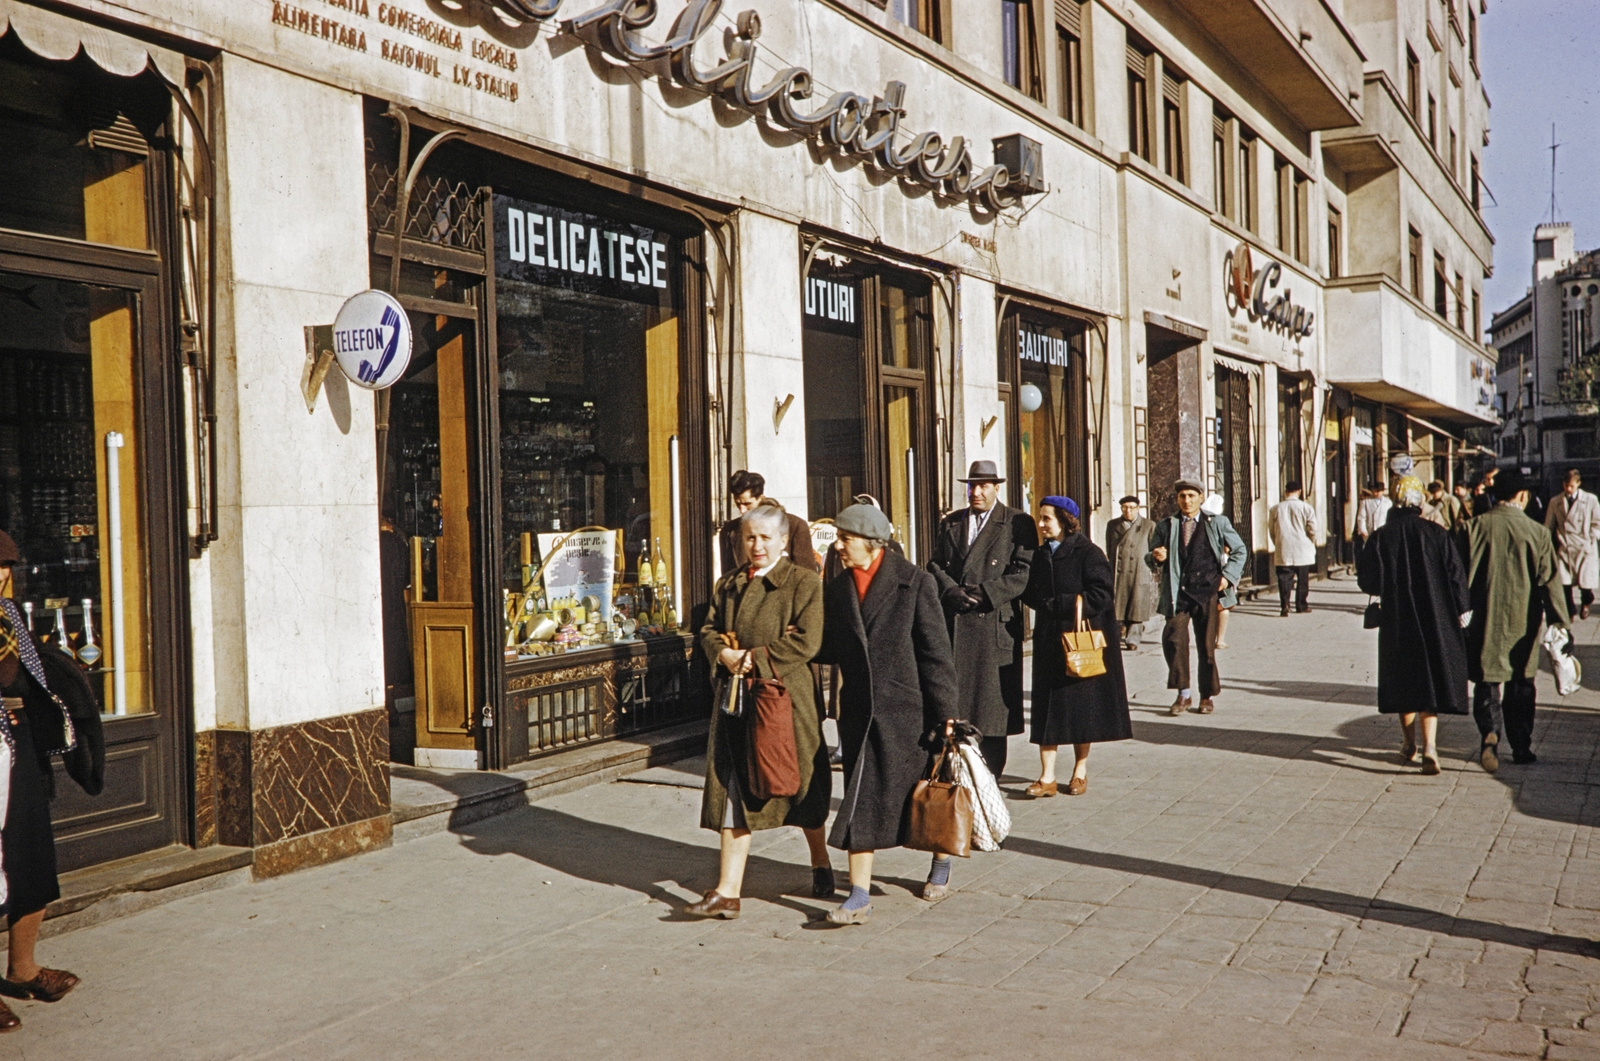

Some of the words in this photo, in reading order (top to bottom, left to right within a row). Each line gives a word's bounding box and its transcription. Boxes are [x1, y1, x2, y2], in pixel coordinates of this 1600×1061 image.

[271, 0, 368, 53] ALIMENTARA
[381, 38, 441, 78] RAIONUL
[475, 71, 518, 102] STALIN
[378, 3, 463, 52] COMERCIALA
[471, 37, 518, 72] LOCALA
[507, 208, 667, 288] DELICATESE
[335, 327, 384, 353] TELEFON
